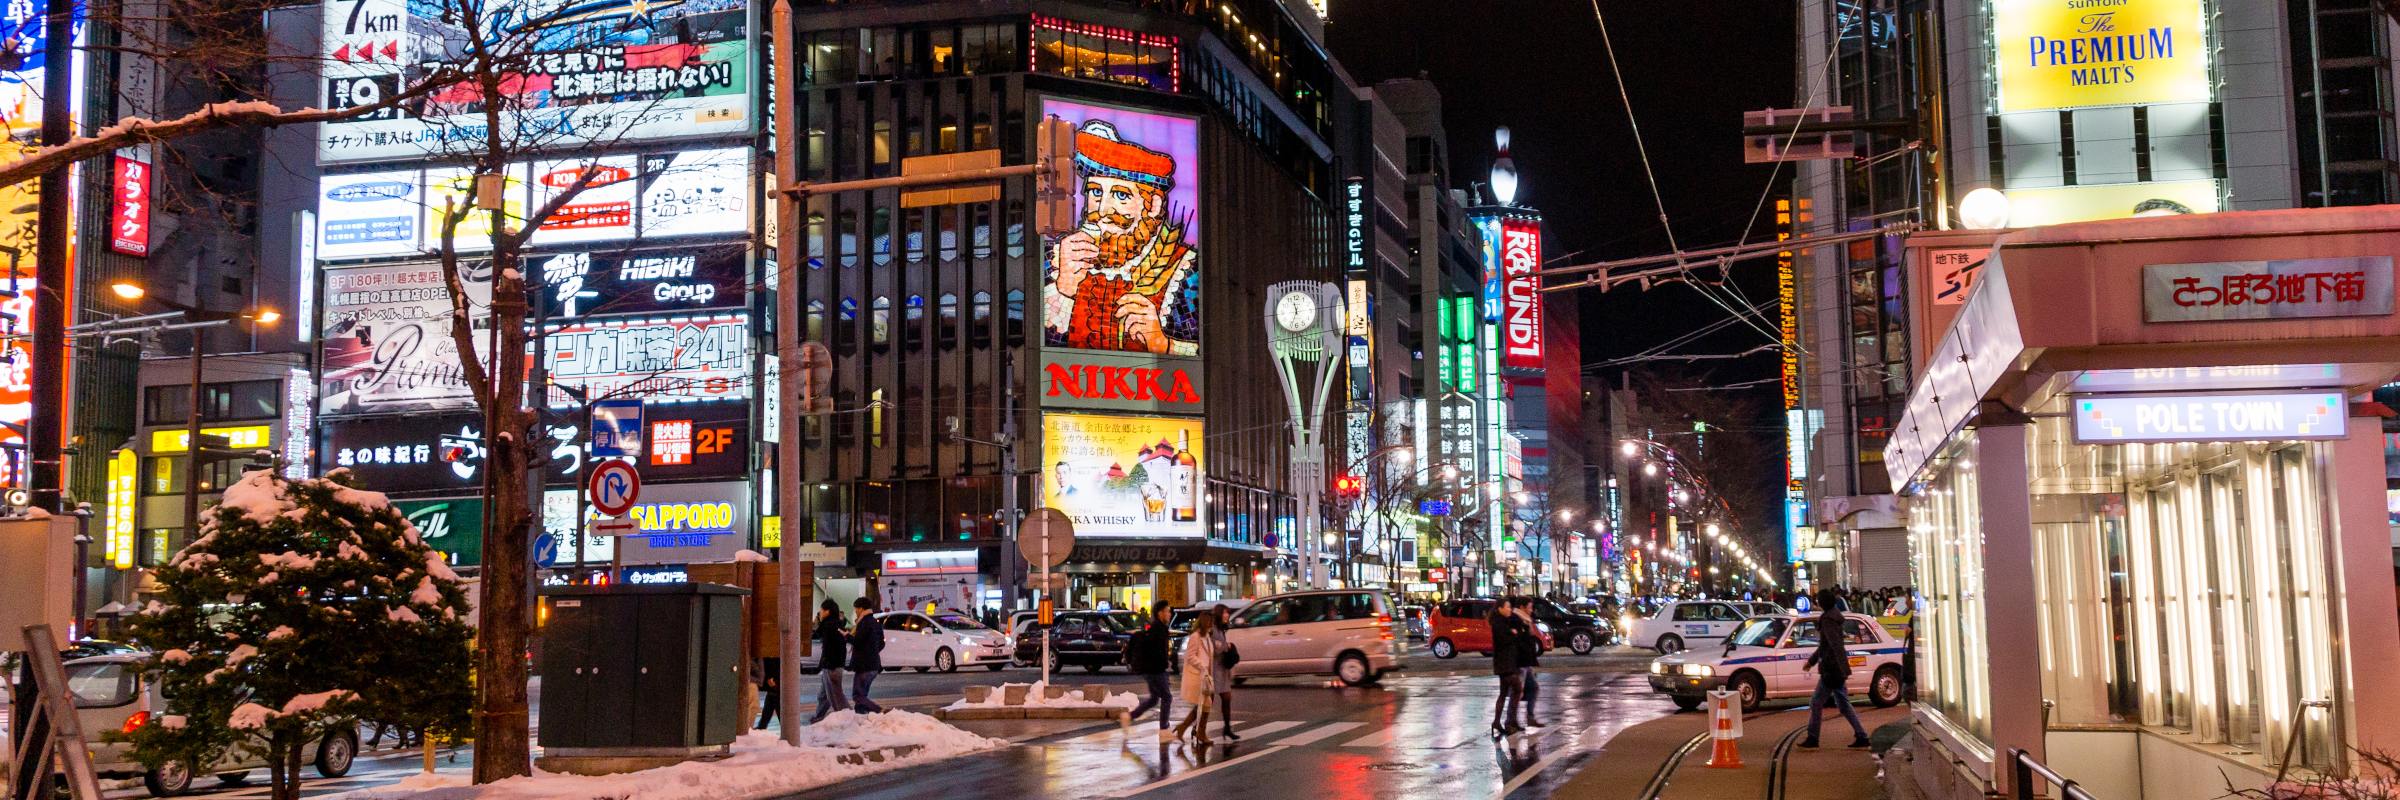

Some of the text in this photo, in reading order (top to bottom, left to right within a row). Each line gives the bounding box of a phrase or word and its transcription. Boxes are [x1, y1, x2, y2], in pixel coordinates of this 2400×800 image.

[2077, 12, 2115, 33] The
[2030, 27, 2173, 66] PREMIUM
[2072, 64, 2134, 86] MALT'S
[328, 131, 412, 149] チケット購入は
[553, 172, 577, 185] FOR
[122, 161, 142, 237] カラオケ
[1348, 184, 1363, 266] すすきのビル
[1935, 253, 1970, 265] 地下鉄
[330, 287, 450, 306] 札幌屈指の最高級店OPE
[654, 282, 715, 304] Group
[2173, 271, 2365, 307] さっぽろ地下街
[1044, 362, 1201, 404] NIKKA
[2136, 401, 2284, 434] POLE TOWN
[696, 428, 733, 454] 2F
[338, 444, 431, 466] 北の味紀行
[1457, 405, 1473, 506] 第23桂和ビル
[629, 502, 733, 530] SAPPORO
[1094, 515, 1136, 525] WHISKY
[679, 533, 711, 547] STORE
